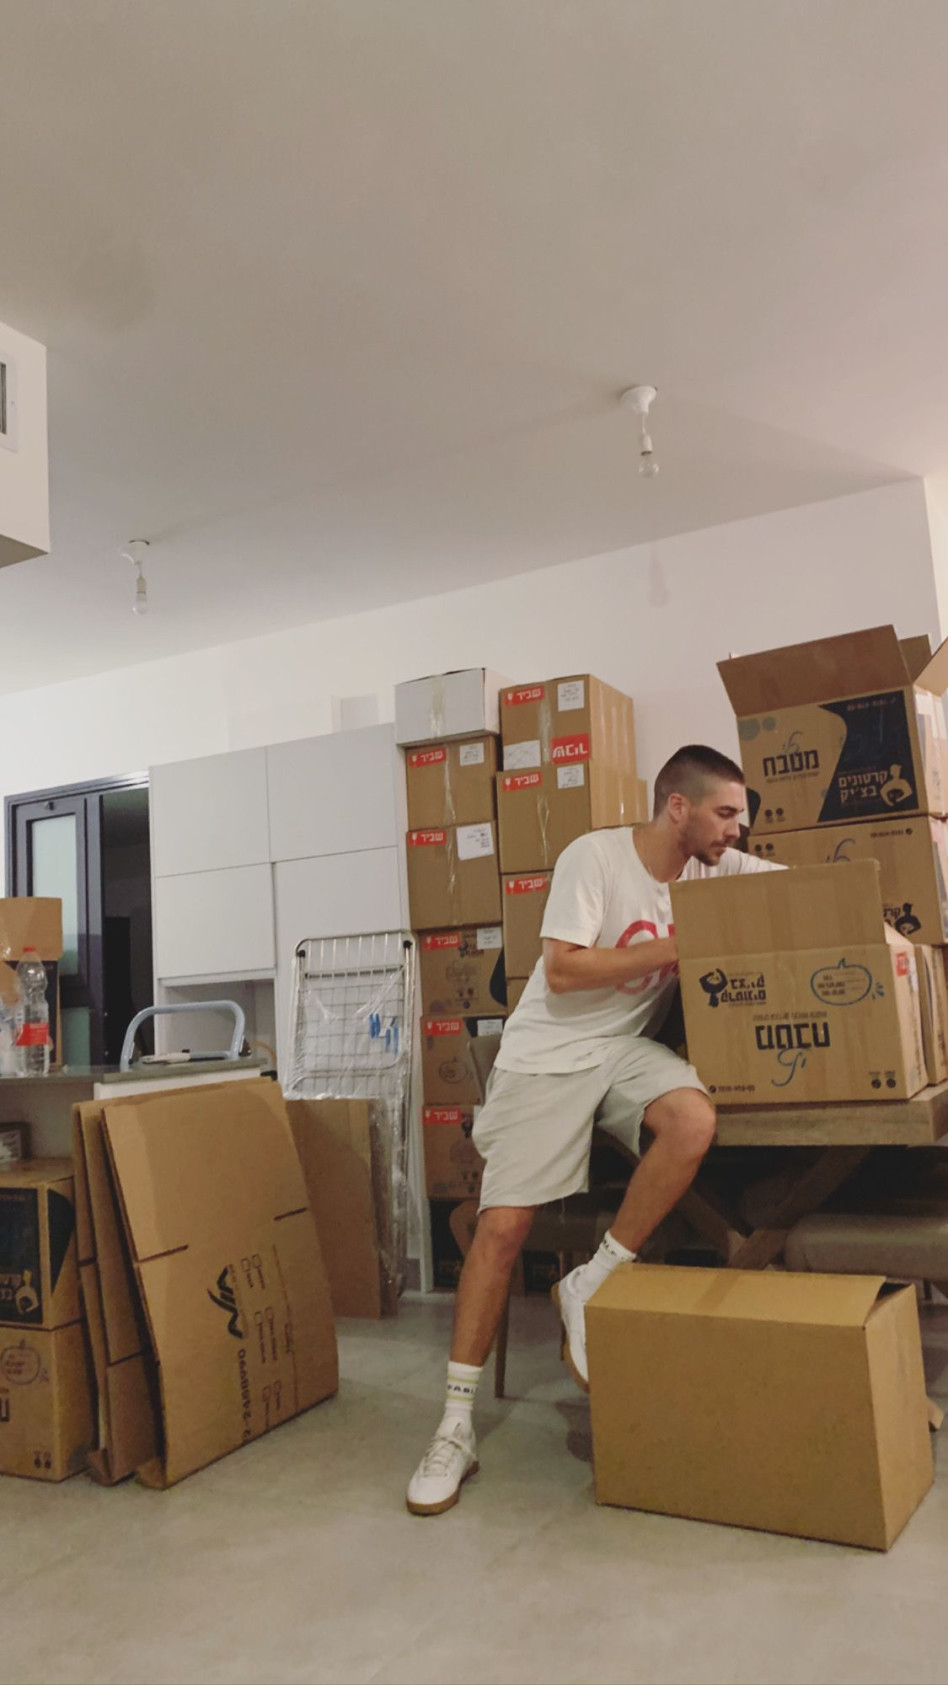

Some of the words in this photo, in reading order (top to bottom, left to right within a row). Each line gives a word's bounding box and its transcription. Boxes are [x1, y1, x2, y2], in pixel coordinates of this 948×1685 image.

[516, 689, 542, 700] שביר
[420, 750, 443, 762] שביר
[552, 742, 588, 760] שביר
[763, 750, 819, 776] מטבח
[514, 772, 540, 785] שביר
[838, 771, 888, 787] קרטונים
[420, 832, 443, 843] שביר
[519, 879, 545, 891] שביר
[434, 935, 459, 946] שביר
[720, 989, 767, 1003] קרטונים
[435, 1020, 461, 1032] שביר
[755, 1023, 830, 1050] מטבח
[433, 1110, 459, 1121] שביר
